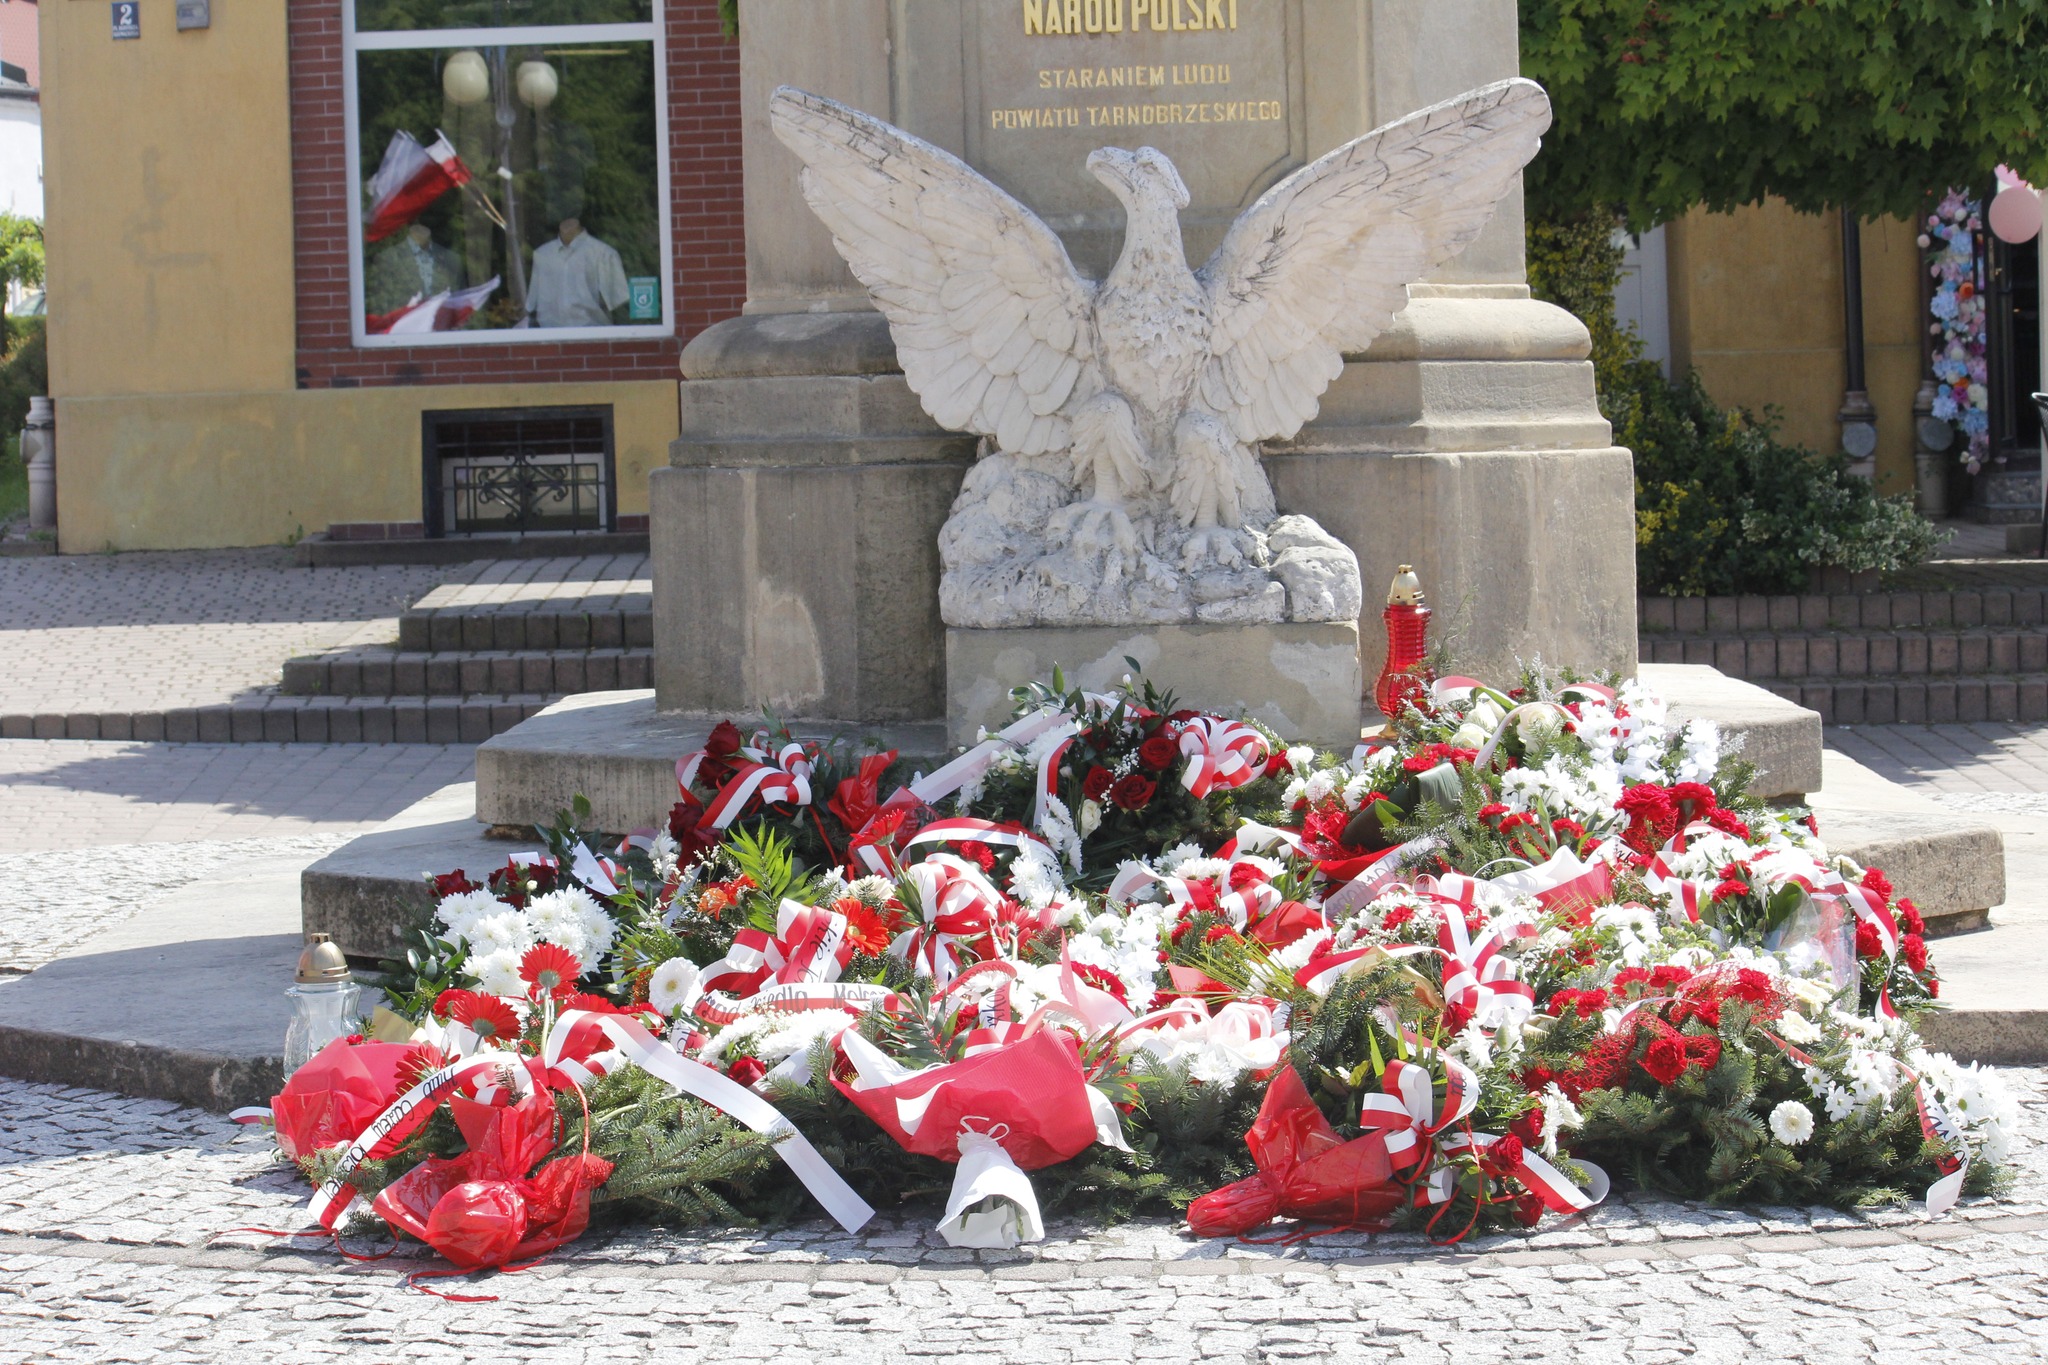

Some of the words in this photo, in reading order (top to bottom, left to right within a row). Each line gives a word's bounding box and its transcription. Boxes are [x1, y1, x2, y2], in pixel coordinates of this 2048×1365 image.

[120, 4, 132, 25] 2
[1131, 0, 1238, 32] POLSKI
[1038, 66, 1165, 89] STARANIEM
[1172, 63, 1231, 85] LUDU
[991, 108, 1079, 129] POWIATU
[1086, 100, 1282, 126] TARNOBRZESKIEGO
